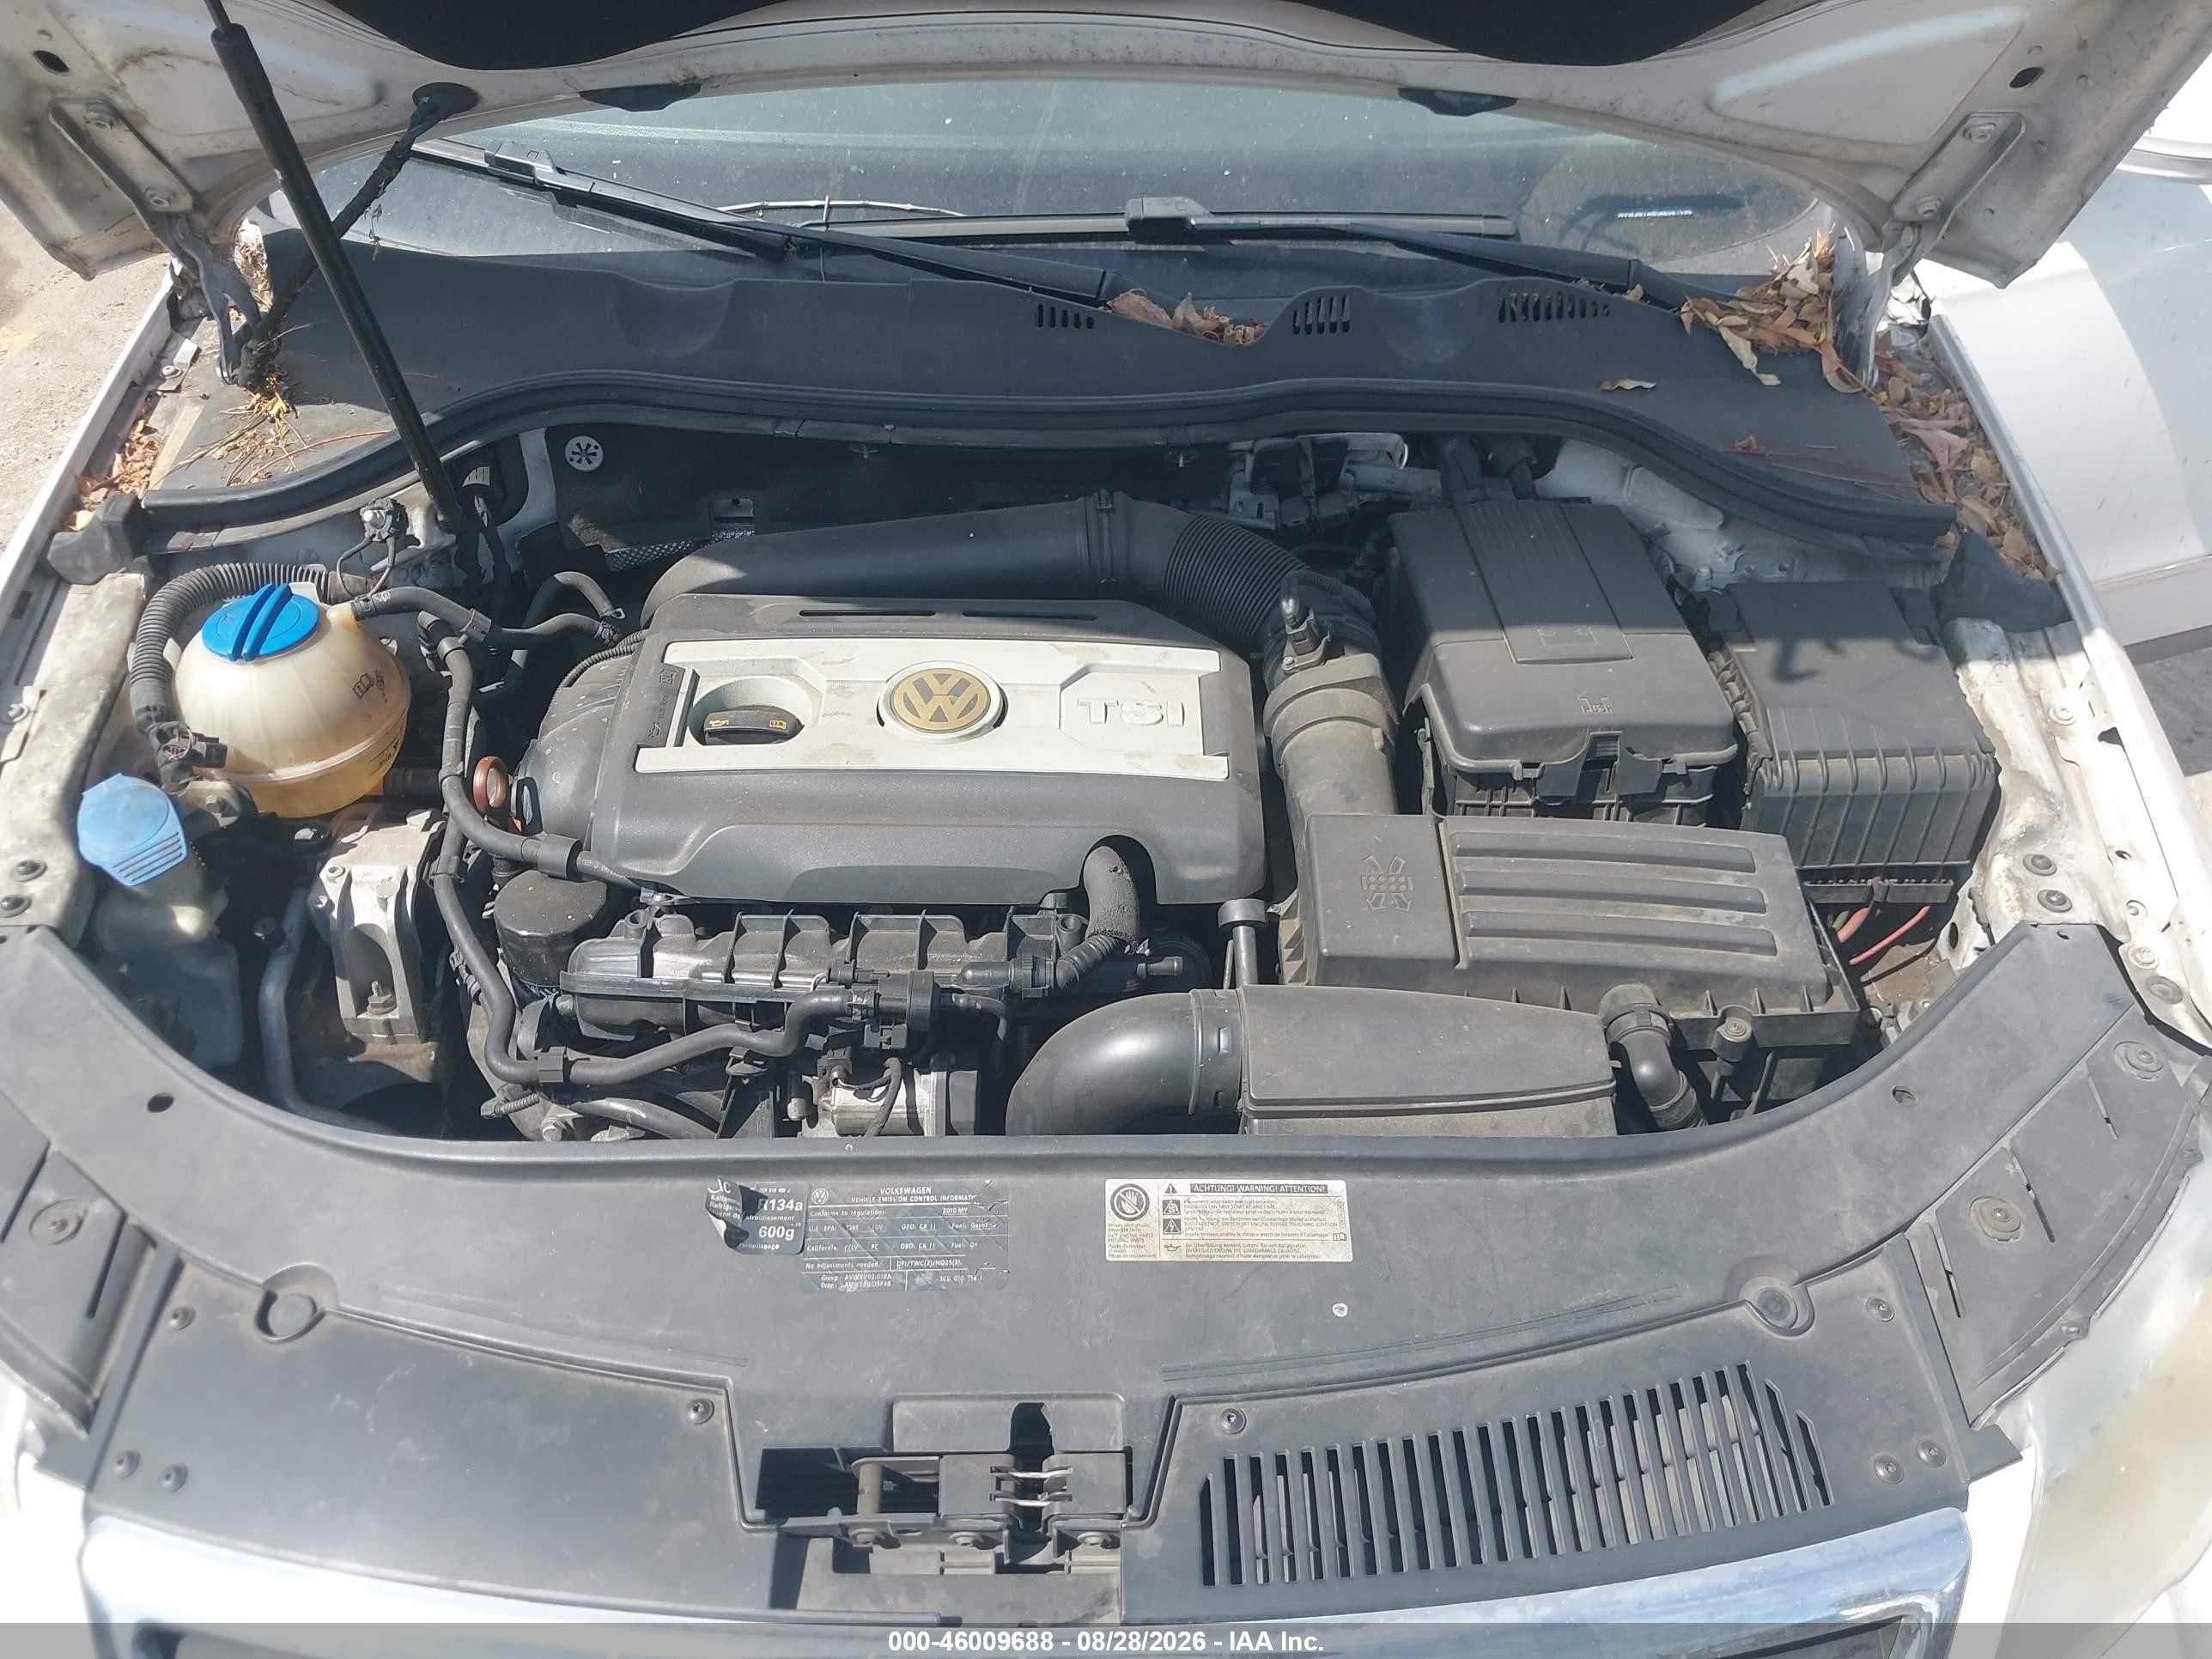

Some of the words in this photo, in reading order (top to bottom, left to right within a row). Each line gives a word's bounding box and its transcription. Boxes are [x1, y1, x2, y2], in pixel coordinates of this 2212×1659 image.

[1077, 698, 1185, 727] TSI
[879, 1187, 932, 1195] VOLKSWAGEN
[1194, 1184, 1235, 1194] ACHTUNG!
[1237, 1184, 1279, 1194] WARNING!
[1279, 1184, 1326, 1194] ATTENTION!
[758, 1225, 795, 1241] 600g
[817, 1261, 854, 1271] adjustments
